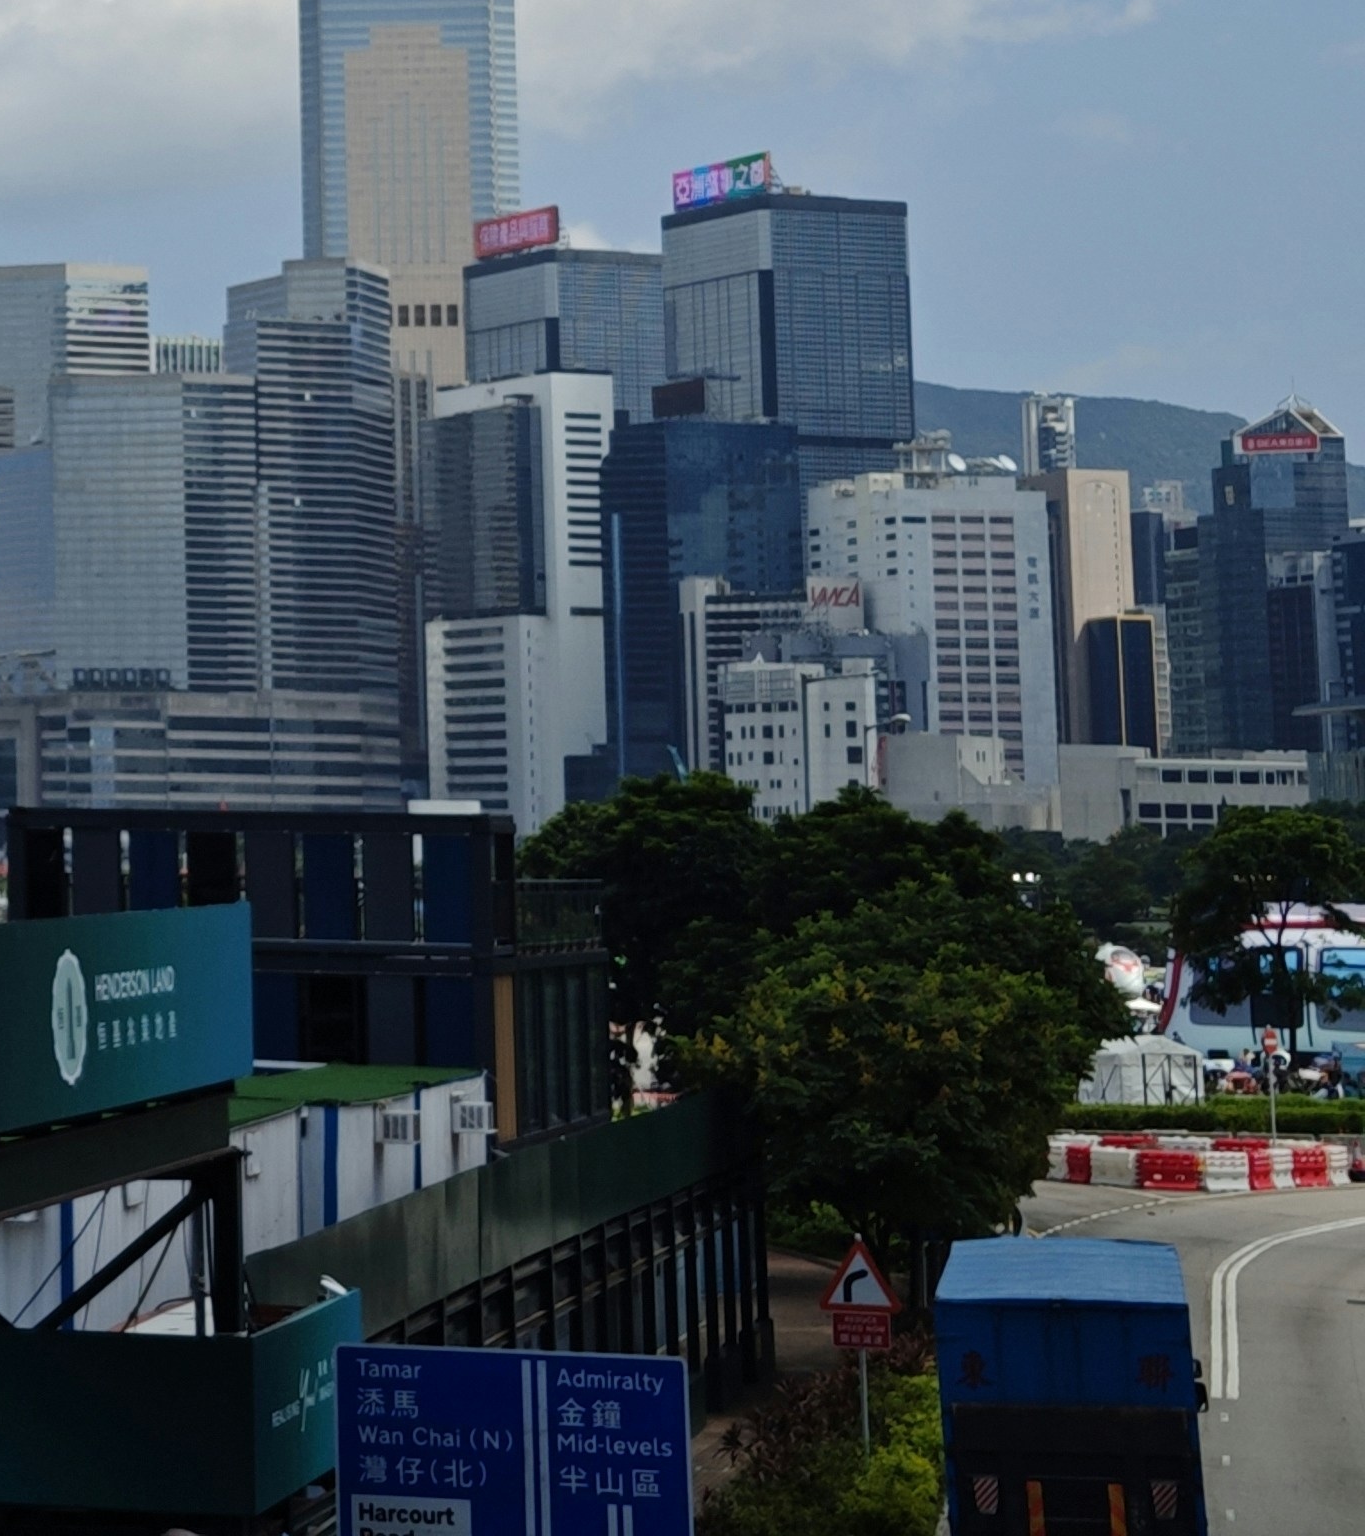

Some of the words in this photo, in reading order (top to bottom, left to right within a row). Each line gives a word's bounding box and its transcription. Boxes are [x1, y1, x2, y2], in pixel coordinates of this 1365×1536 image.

[95, 968, 150, 1001] HENDERSON
[151, 965, 175, 994] LAND
[356, 1358, 422, 1380] Tamar
[556, 1367, 664, 1397] Admiralty
[356, 1387, 420, 1419] 添馬
[557, 1397, 622, 1430] 金鐘
[358, 1425, 404, 1446] Wan
[412, 1426, 461, 1448] Chai
[557, 1433, 673, 1458] Mid-levels
[559, 1465, 662, 1498] 半山區
[358, 1502, 455, 1526] Harcourt
